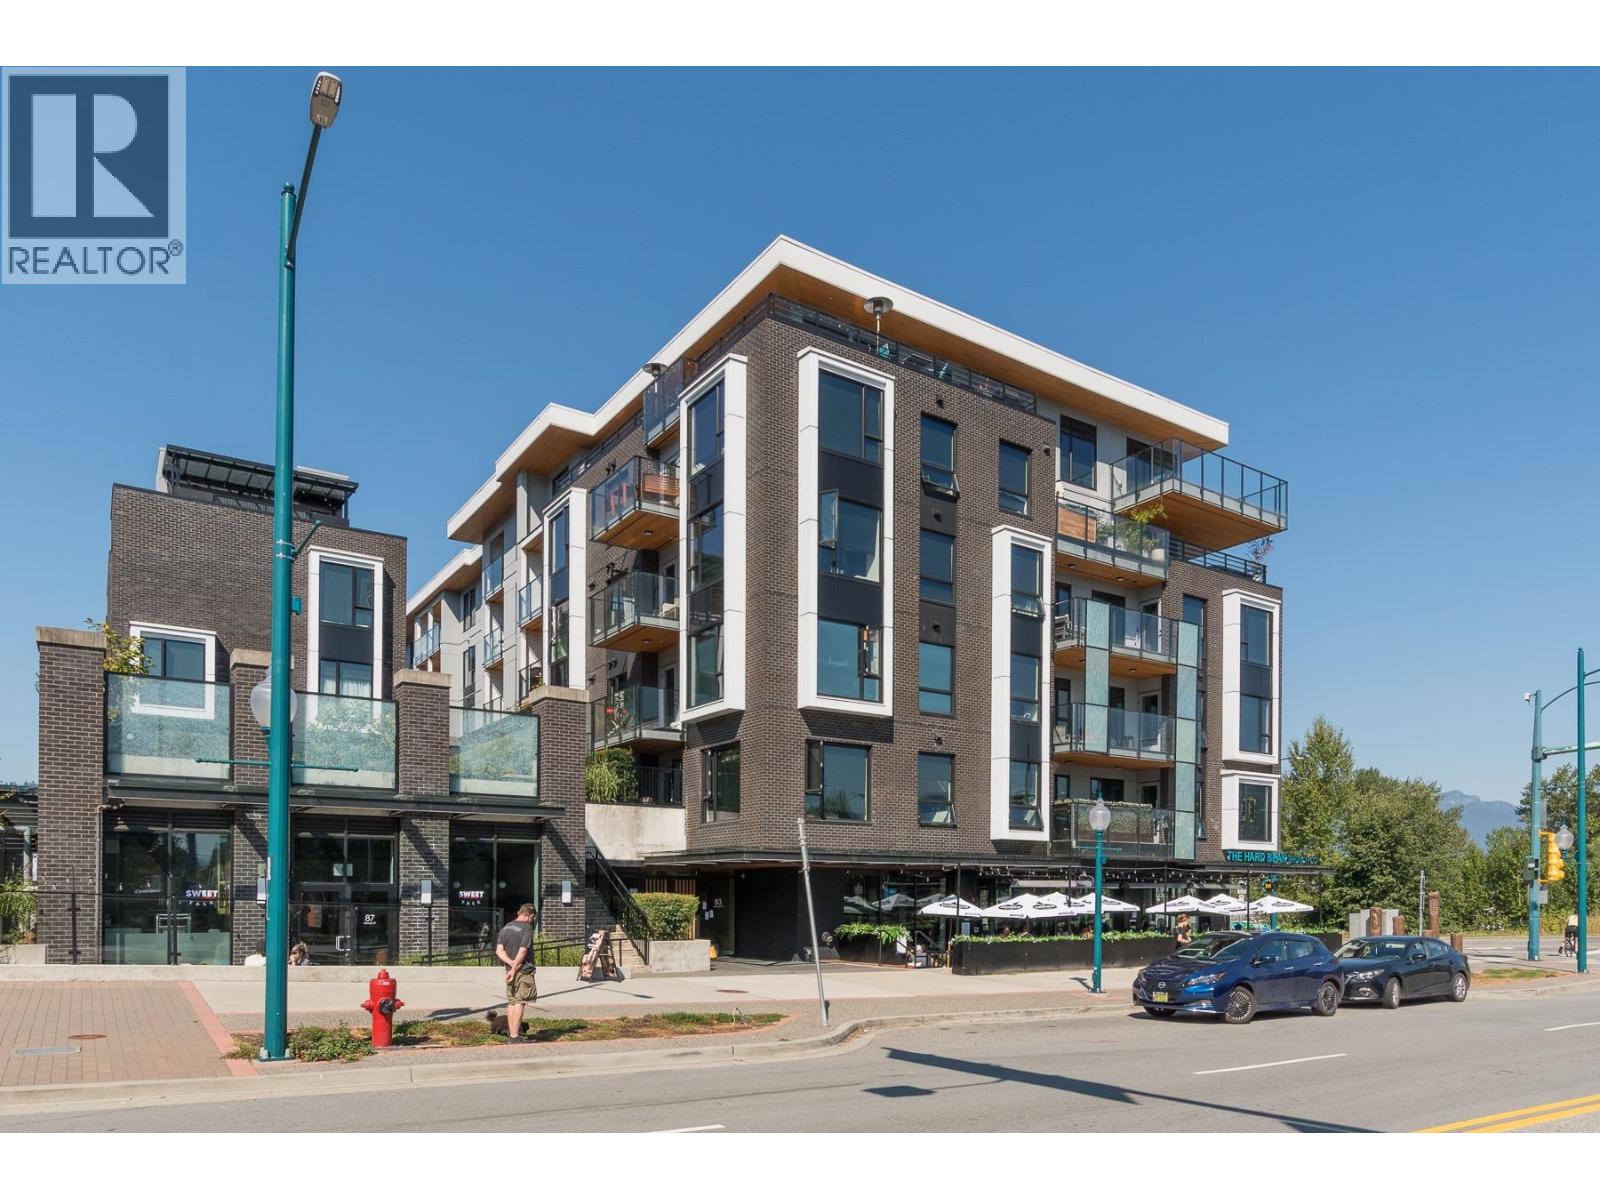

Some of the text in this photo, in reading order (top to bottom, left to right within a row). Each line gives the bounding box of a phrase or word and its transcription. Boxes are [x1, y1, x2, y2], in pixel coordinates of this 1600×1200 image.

[1227, 850, 1243, 861] THE
[1244, 851, 1266, 862] HARD
[185, 889, 218, 898] SWEET
